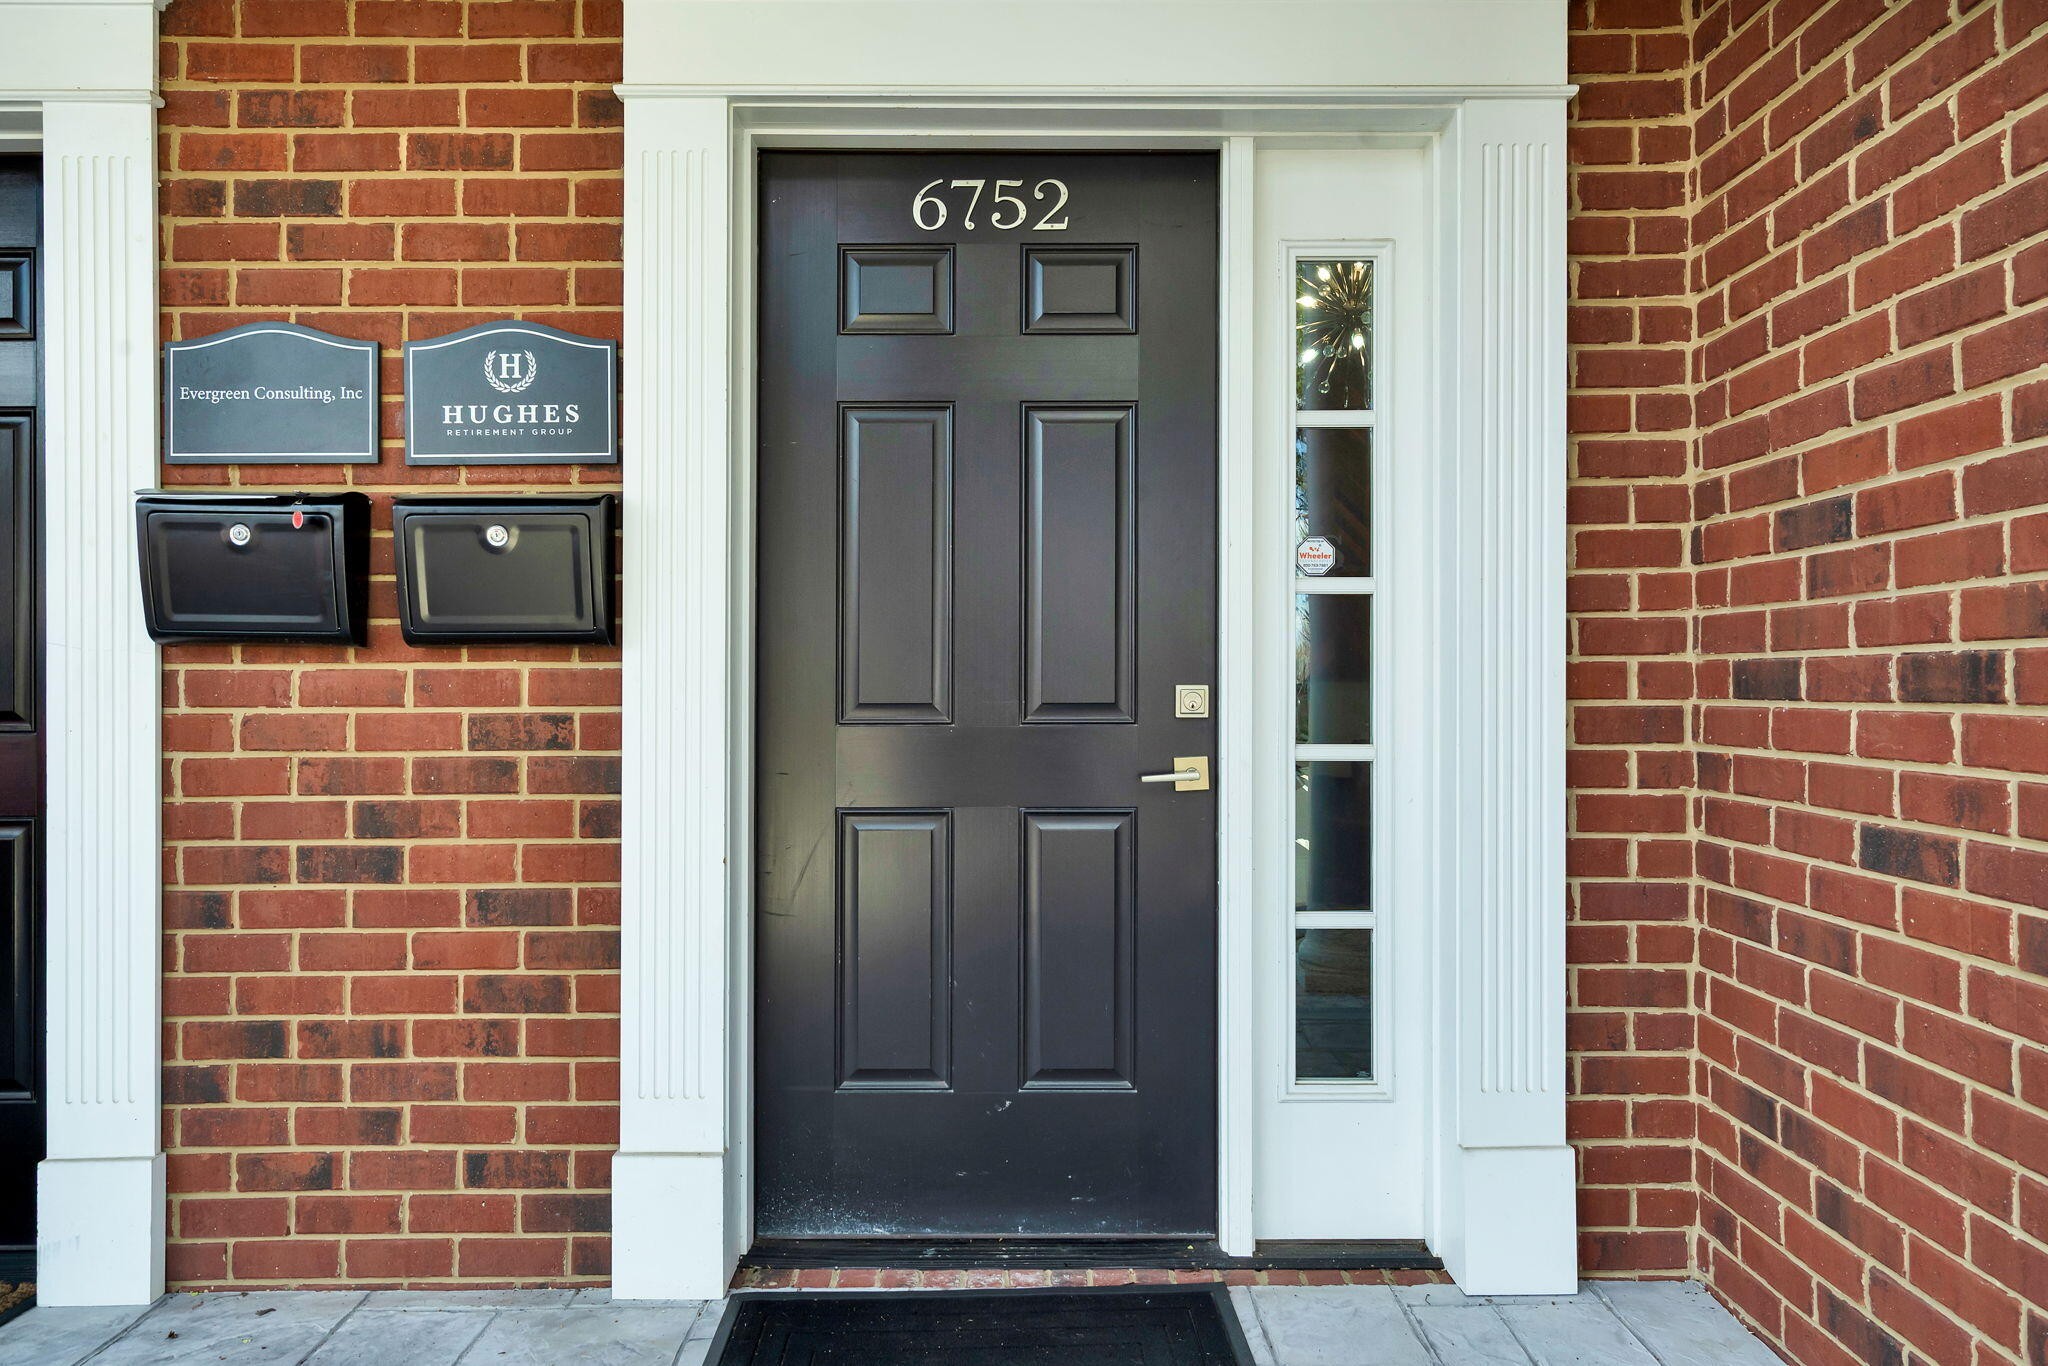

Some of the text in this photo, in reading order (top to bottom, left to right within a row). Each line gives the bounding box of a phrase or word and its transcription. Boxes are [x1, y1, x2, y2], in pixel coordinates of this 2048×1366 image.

[913, 178, 1069, 231] 6752
[499, 353, 522, 379] H
[179, 386, 364, 403] Evergreen Consulting, Inc
[442, 404, 580, 424] HUGHES
[446, 428, 574, 436] RETIREMENT GROUP
